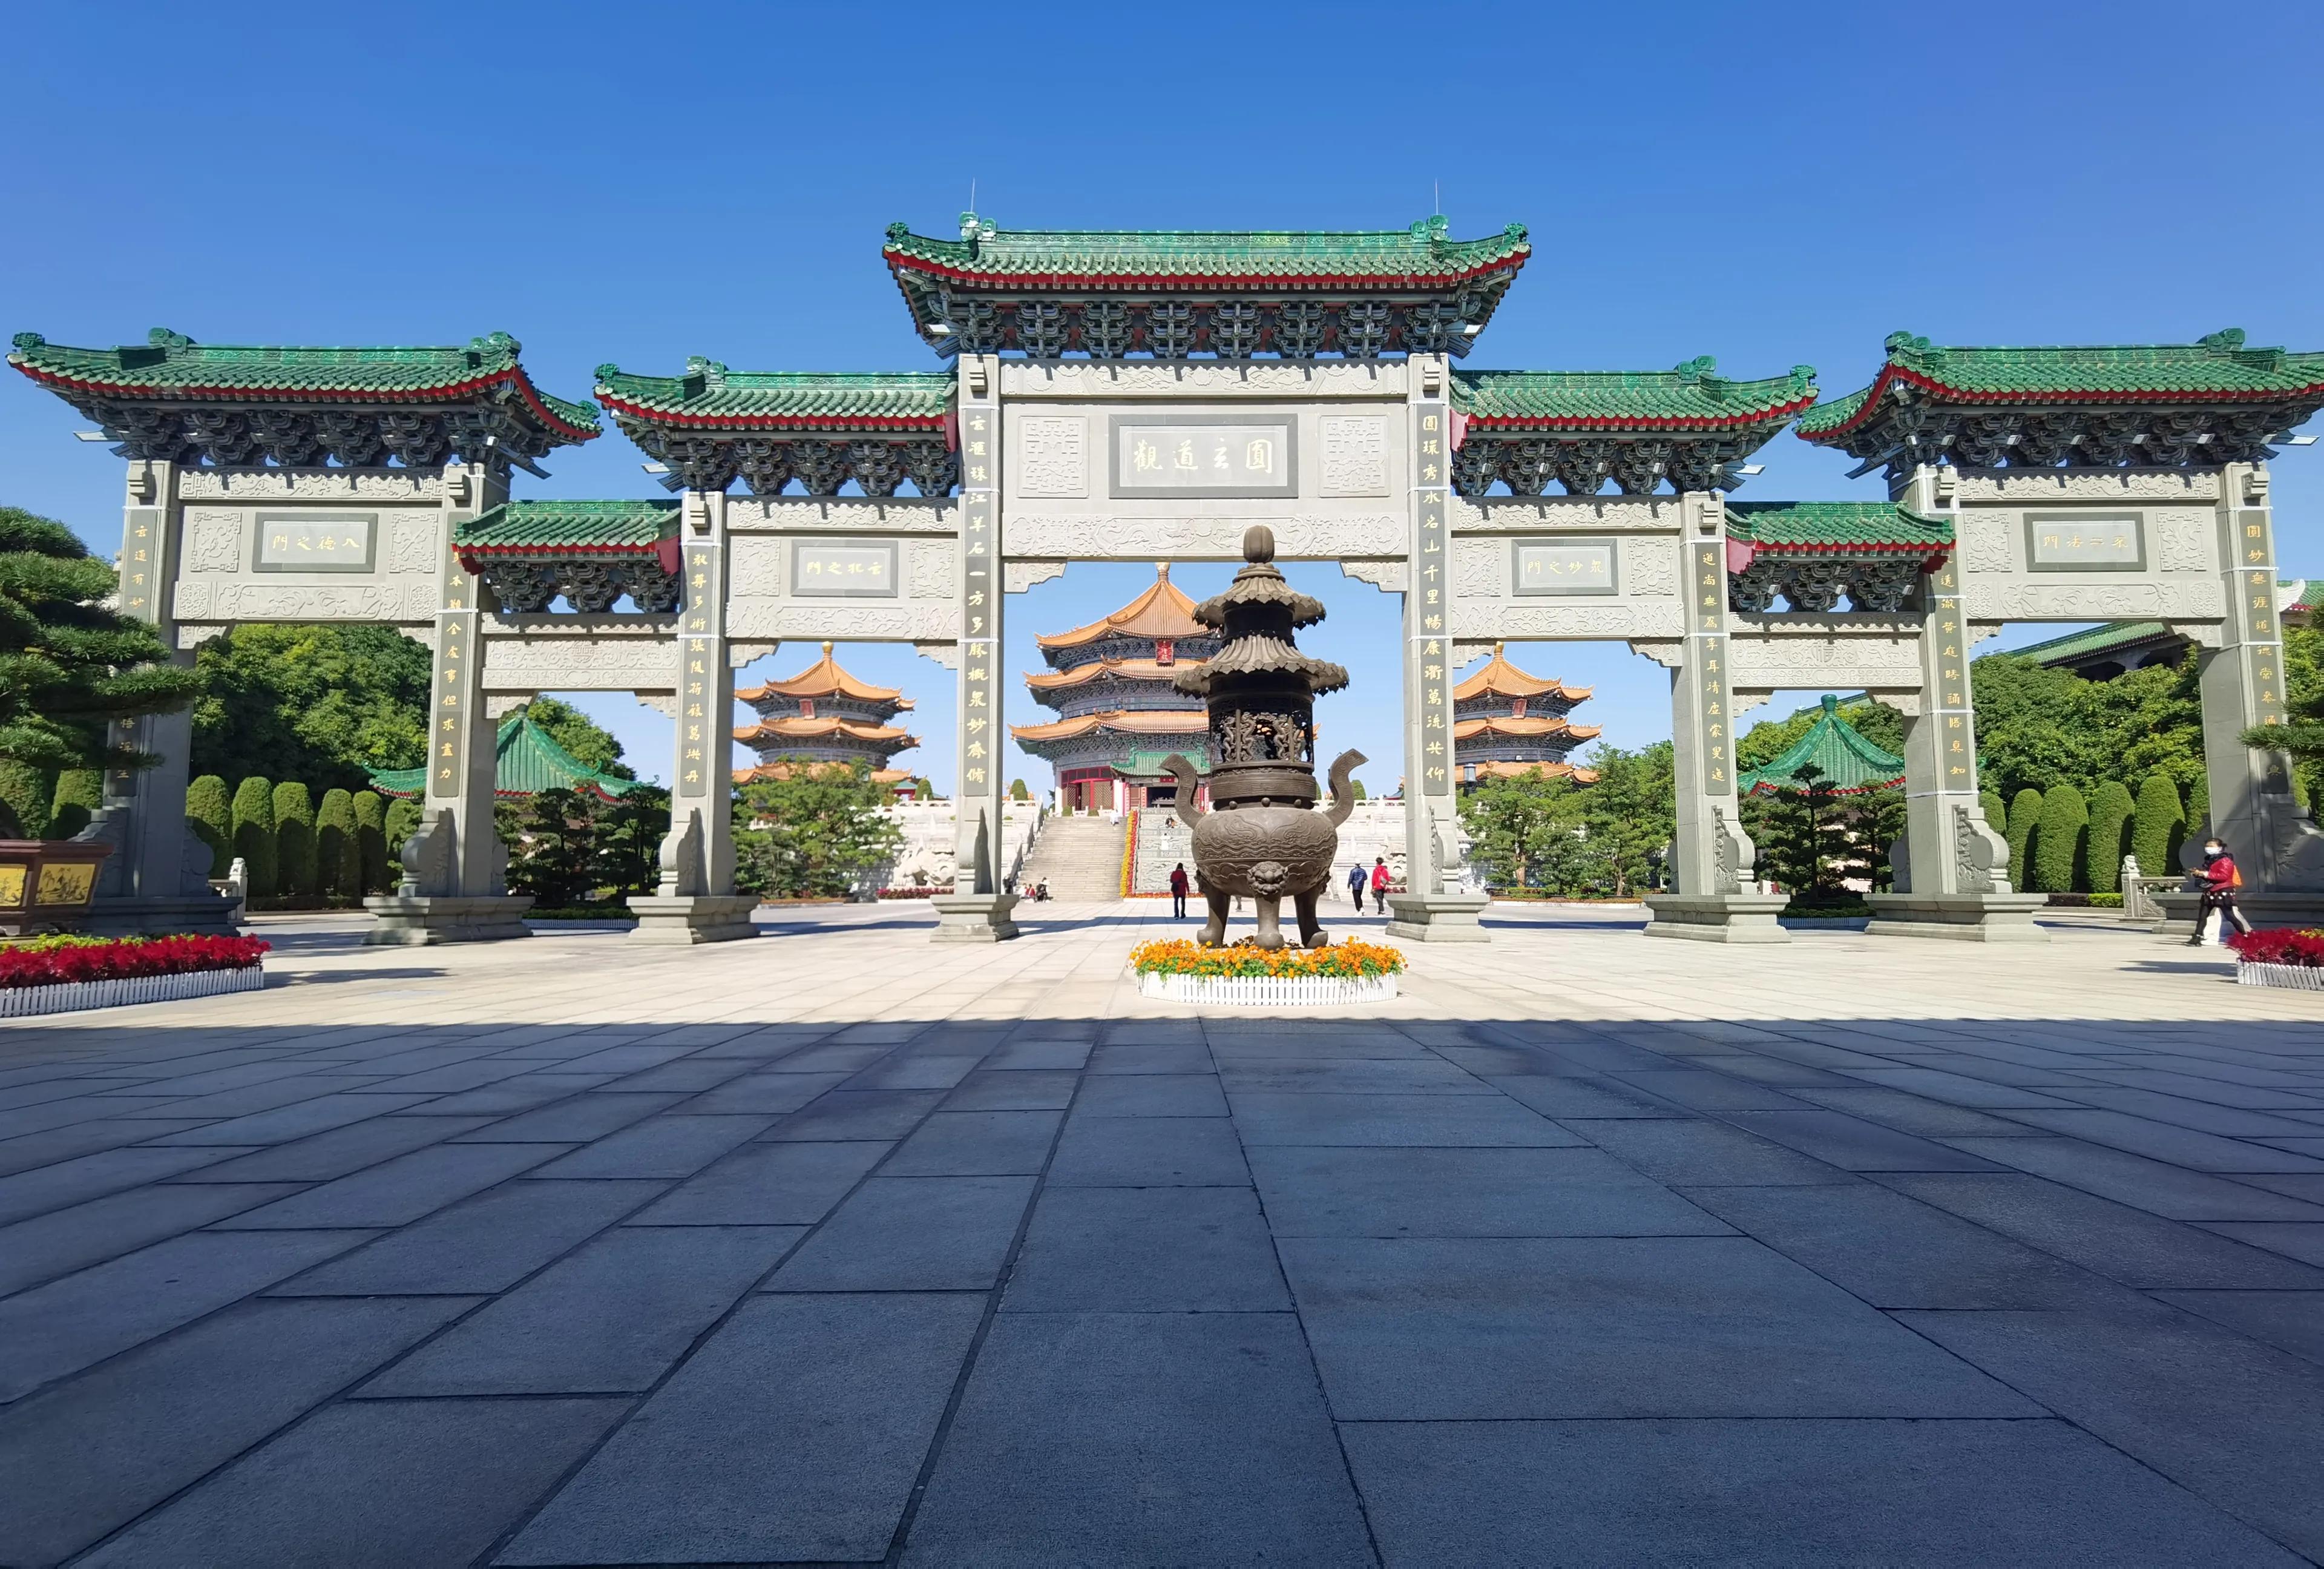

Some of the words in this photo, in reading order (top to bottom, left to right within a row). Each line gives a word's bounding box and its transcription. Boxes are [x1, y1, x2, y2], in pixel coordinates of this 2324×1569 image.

[1133, 438, 1273, 473] 圓玄道觀
[272, 534, 360, 551] 入德之門
[2042, 535, 2129, 550] 不二法門
